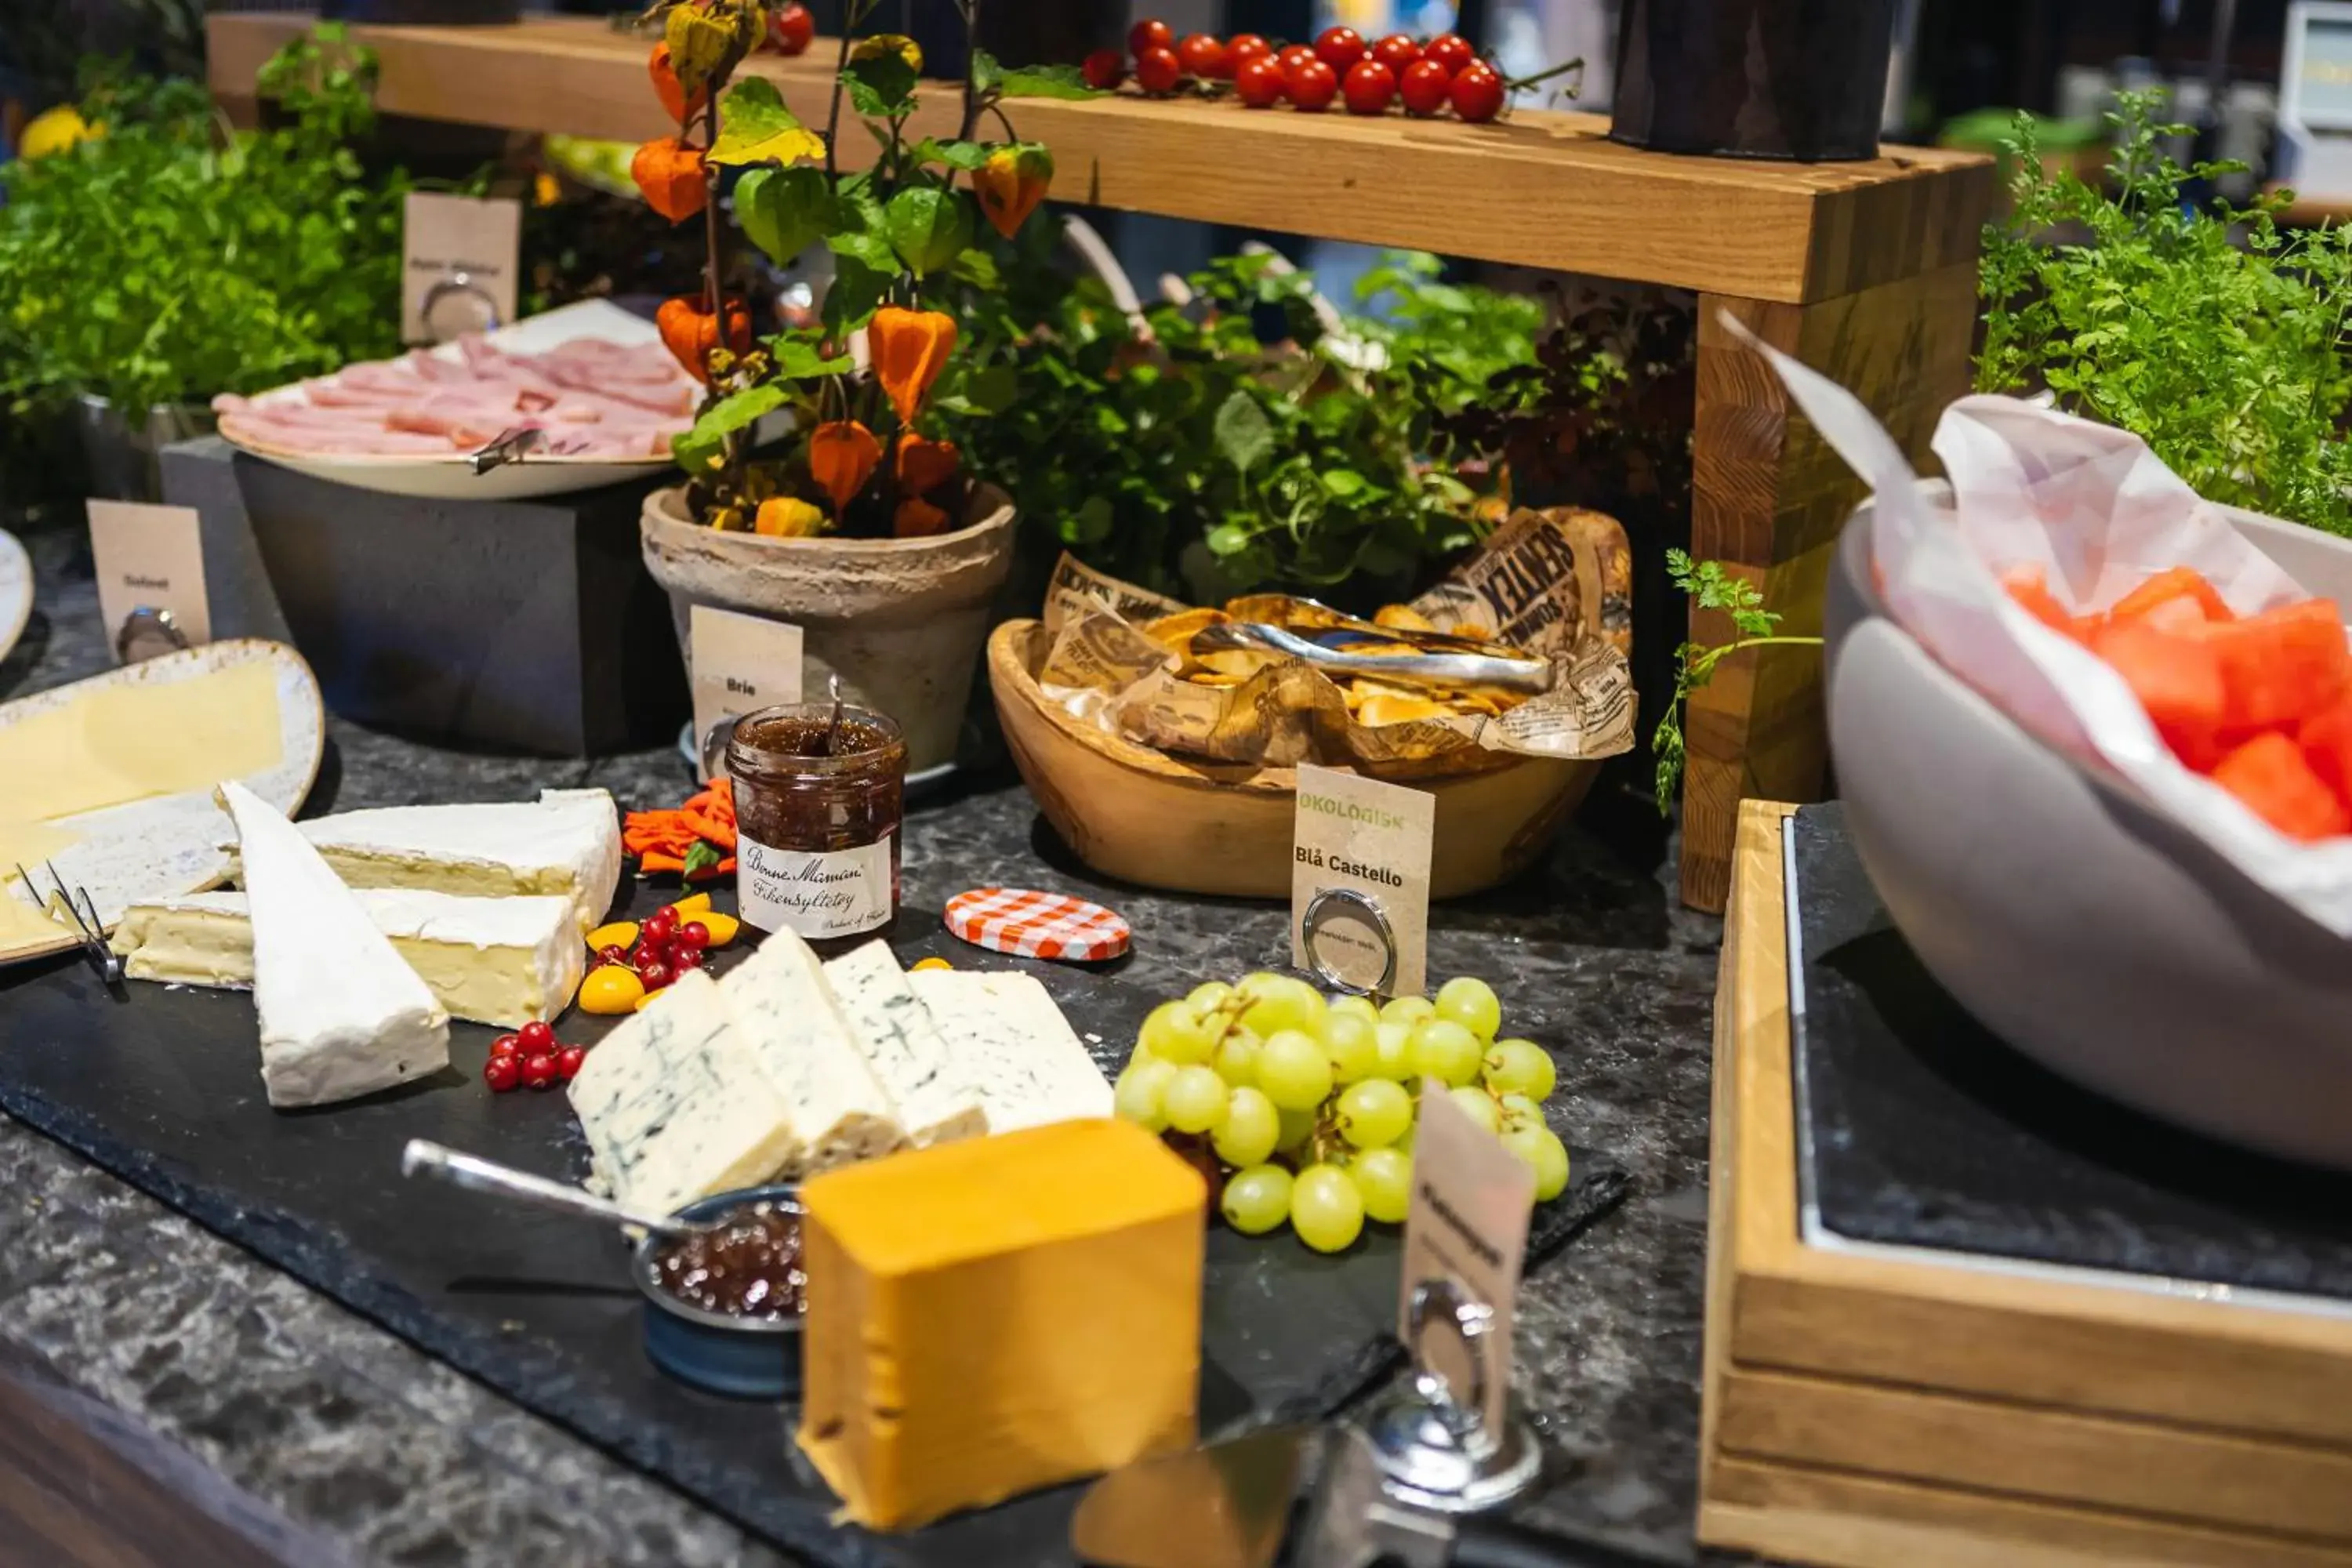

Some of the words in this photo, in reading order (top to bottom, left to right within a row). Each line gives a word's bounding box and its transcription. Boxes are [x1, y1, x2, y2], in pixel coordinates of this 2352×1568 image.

[727, 677, 756, 697] Brie
[746, 846, 791, 881] Bonne
[793, 858, 862, 884] Maman
[1295, 845, 1323, 868] Blå
[1329, 855, 1403, 888] Castello
